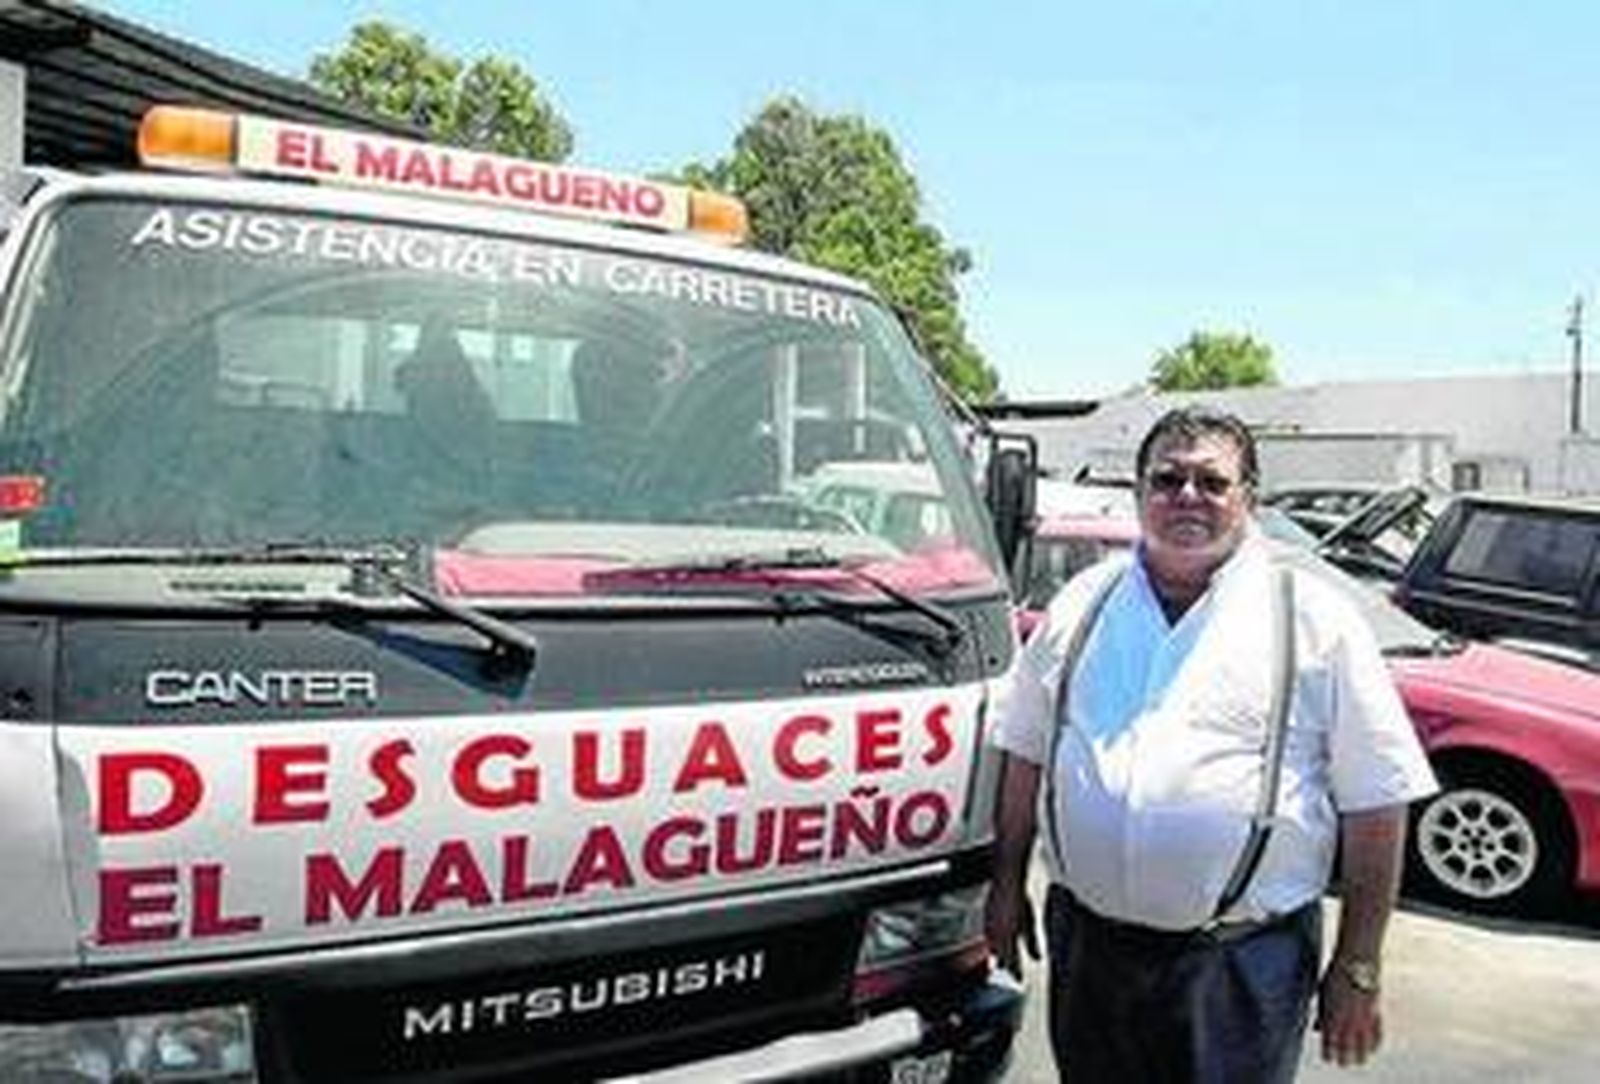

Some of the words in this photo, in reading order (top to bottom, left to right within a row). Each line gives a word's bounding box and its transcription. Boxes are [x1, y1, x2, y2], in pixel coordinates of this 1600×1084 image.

[276, 131, 337, 170] EL
[131, 209, 493, 274] ASISTENCIA
[515, 253, 580, 285] EN
[607, 264, 861, 327] CARRETERA
[146, 671, 377, 704] CANTER
[97, 704, 954, 834] DESGUACES
[96, 863, 262, 945] EL
[305, 786, 952, 926] MALAGUEÑO
[404, 951, 765, 1039] MITSUBISHI
